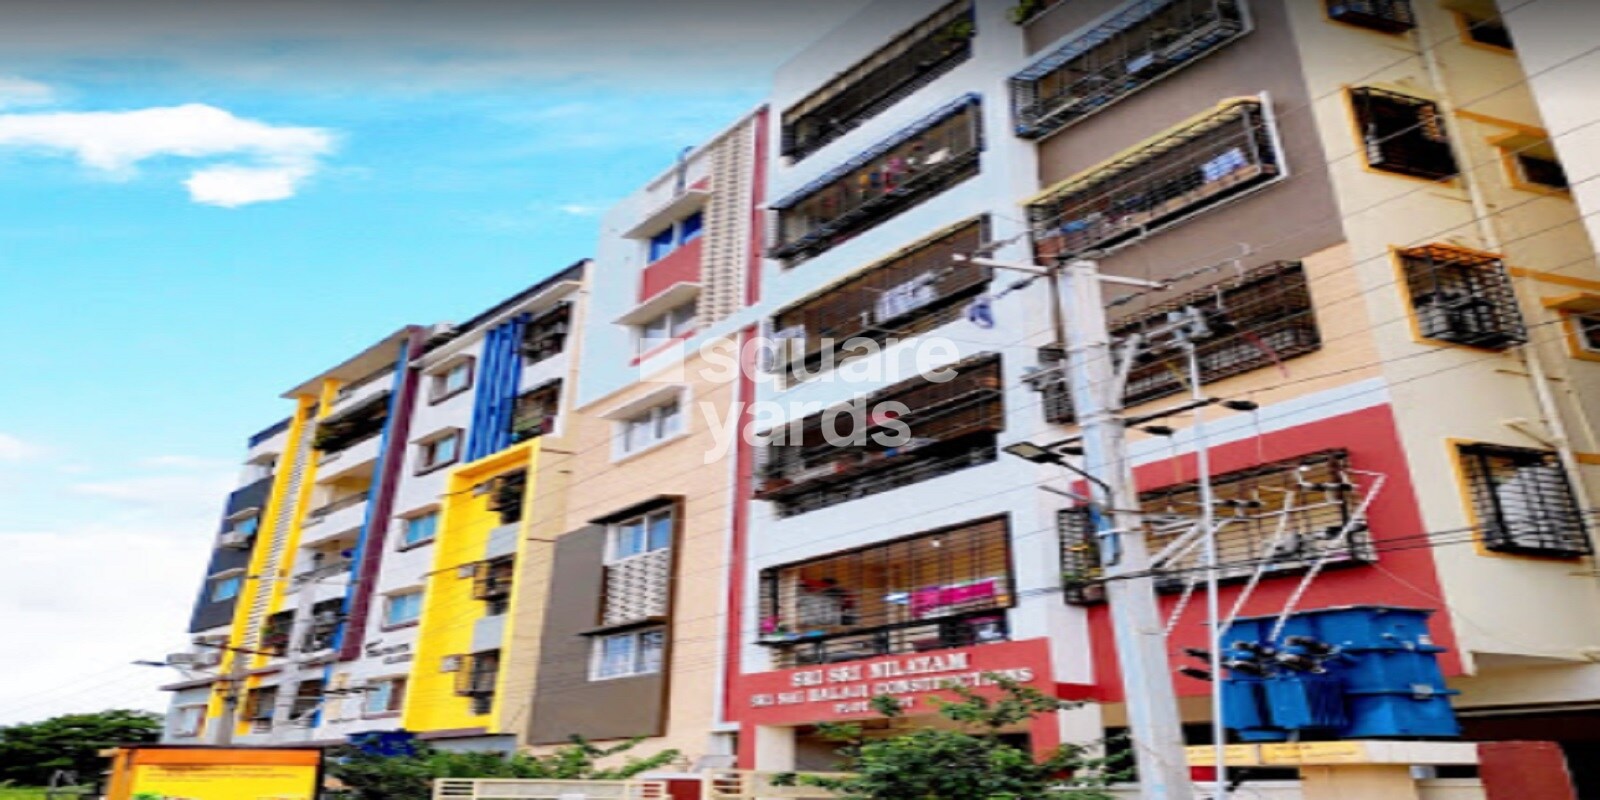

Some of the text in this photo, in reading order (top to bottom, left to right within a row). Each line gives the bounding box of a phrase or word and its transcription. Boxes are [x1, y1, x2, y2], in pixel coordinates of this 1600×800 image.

[791, 653, 968, 688] SRI SRI NILAYAM
